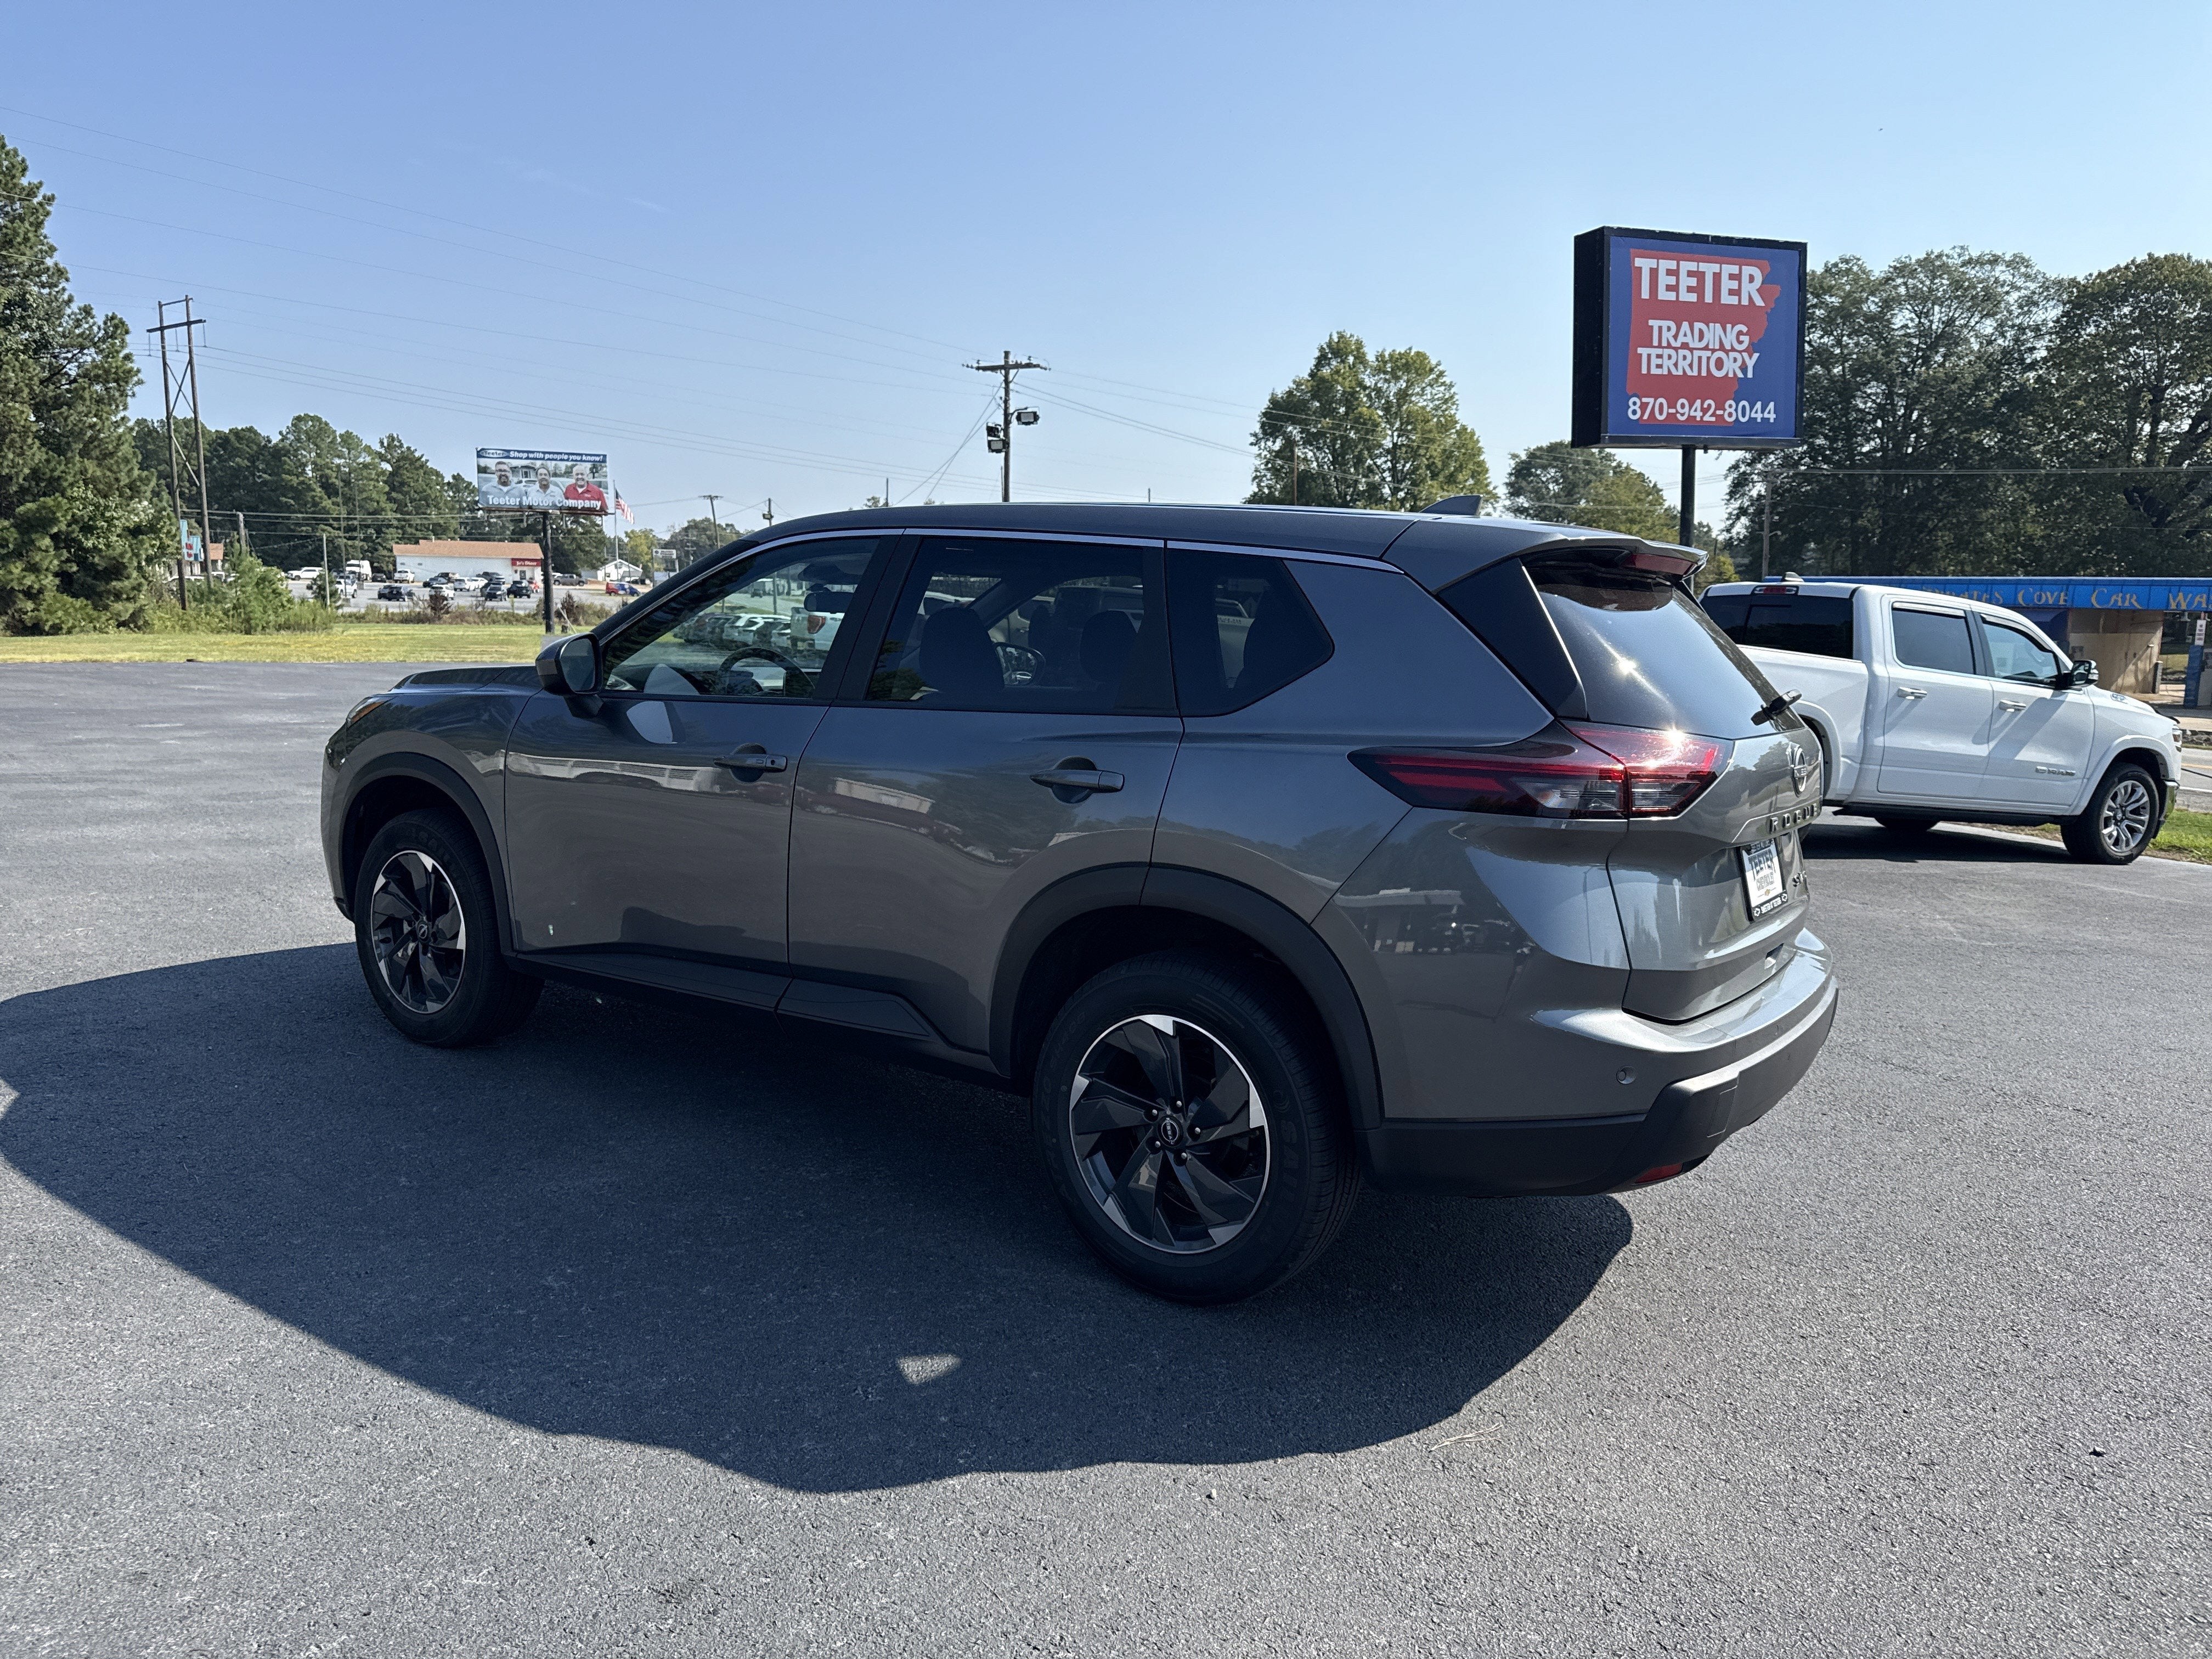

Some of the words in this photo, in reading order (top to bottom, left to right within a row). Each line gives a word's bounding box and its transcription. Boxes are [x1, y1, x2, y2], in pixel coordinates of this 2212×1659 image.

[1634, 258, 1765, 306] TEETER
[1649, 319, 1750, 351] TRADING
[1637, 347, 1760, 379] TERRITORY
[1628, 397, 1776, 423] 870-942-8044
[509, 450, 527, 459] Shop
[487, 495, 521, 505] Teeter
[522, 496, 553, 506] Motor
[555, 498, 602, 510] Company
